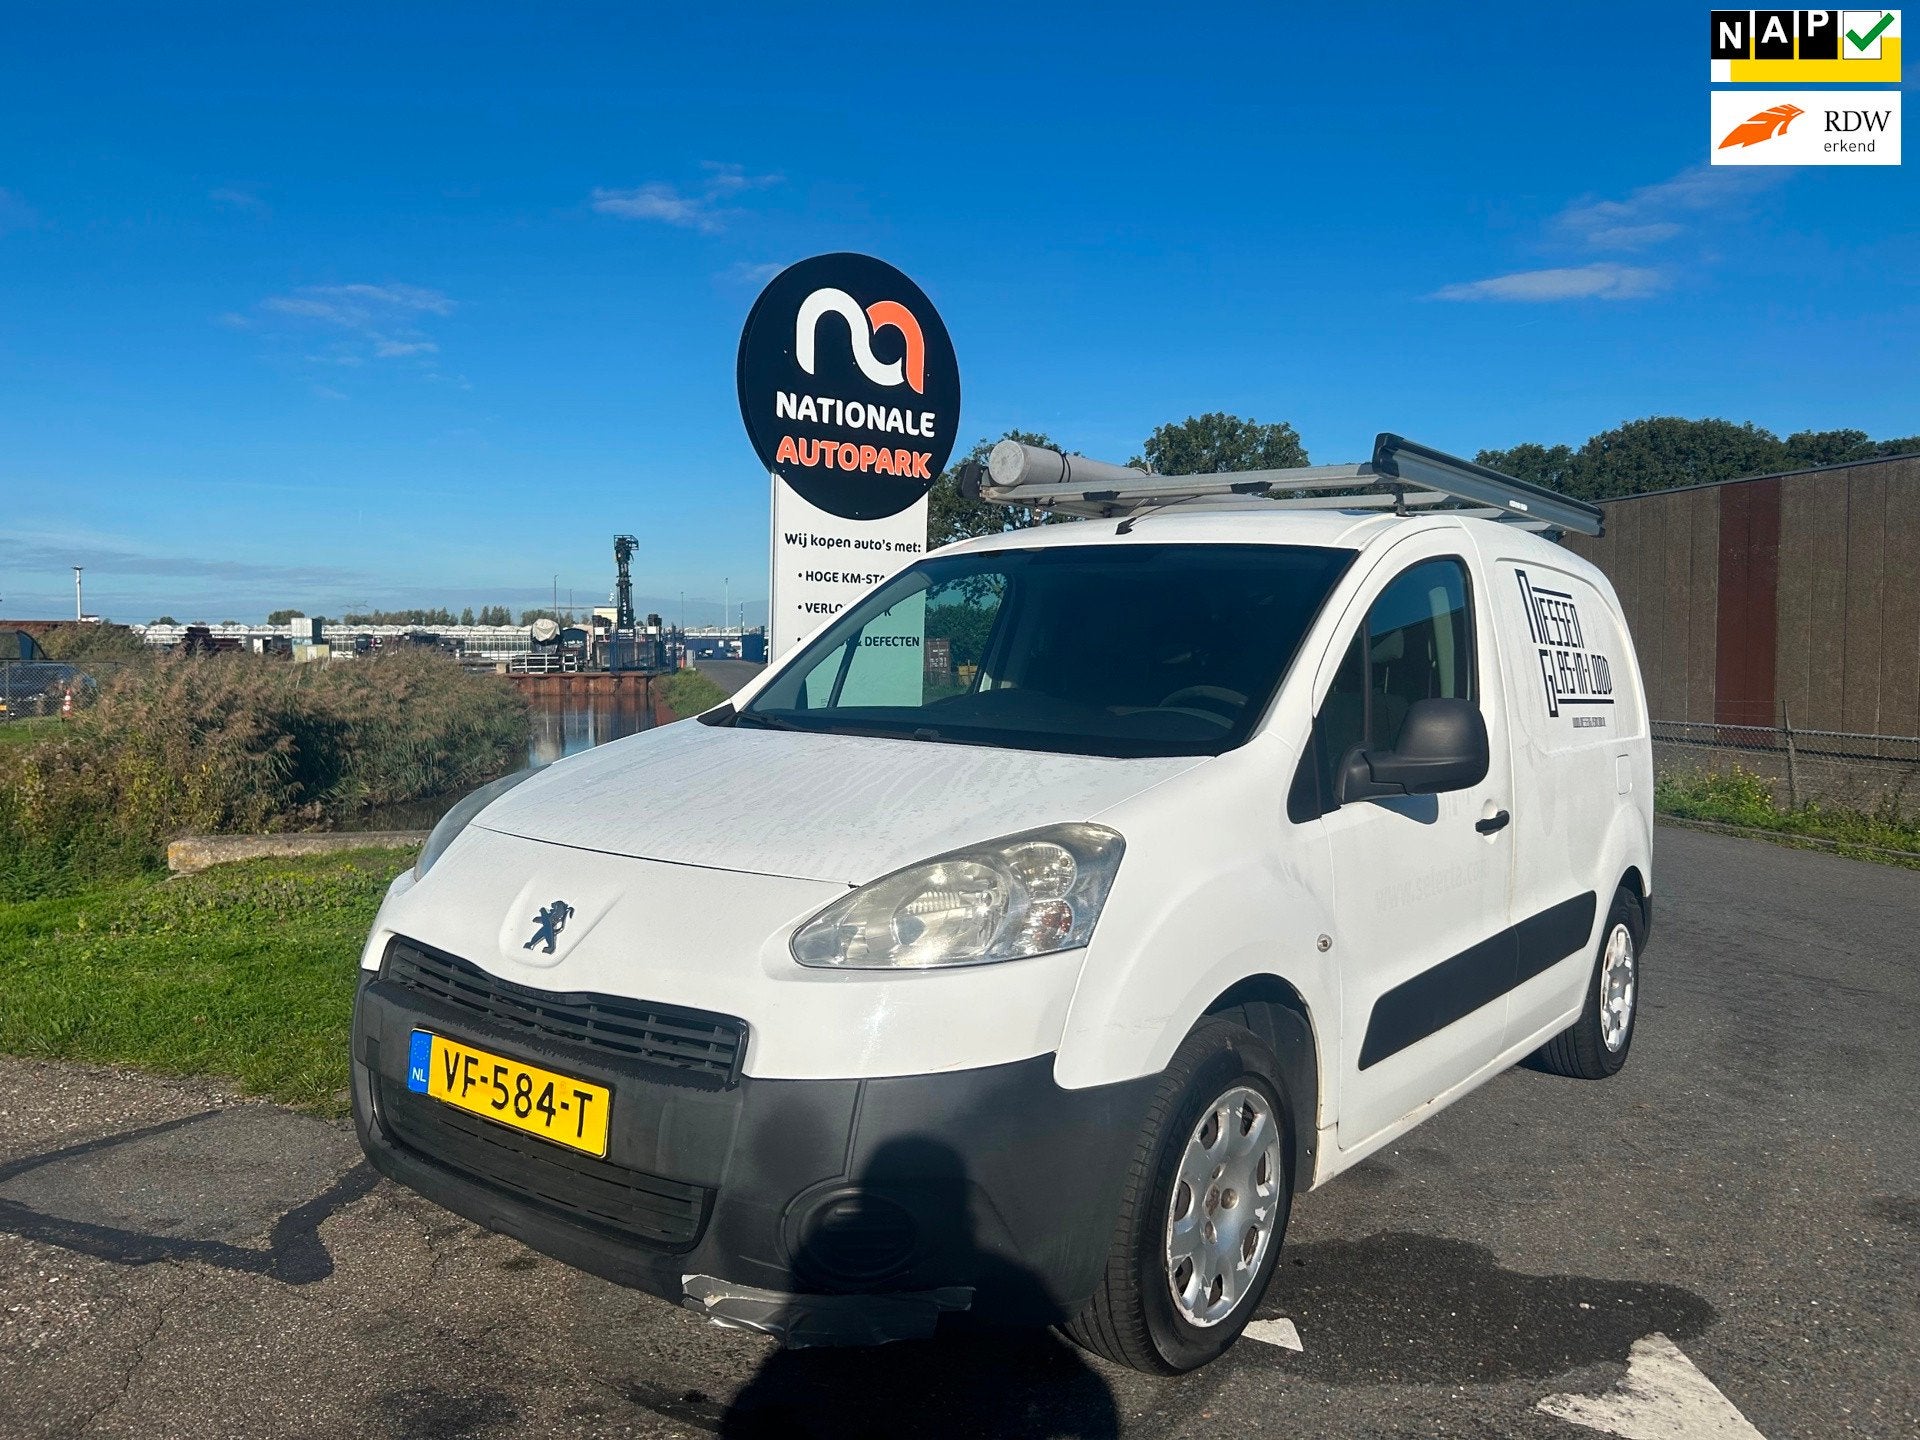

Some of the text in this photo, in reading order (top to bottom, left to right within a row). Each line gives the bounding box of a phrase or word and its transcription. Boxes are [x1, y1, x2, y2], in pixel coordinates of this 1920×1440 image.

[776, 390, 936, 438] NATIONALE
[776, 435, 933, 480] AUTOPARK
[784, 532, 922, 553] Wij kopen auto's met:
[805, 570, 839, 583] HOGE
[864, 636, 920, 647] DEFECTEN
[412, 1047, 593, 1138] NL VF-584-T
